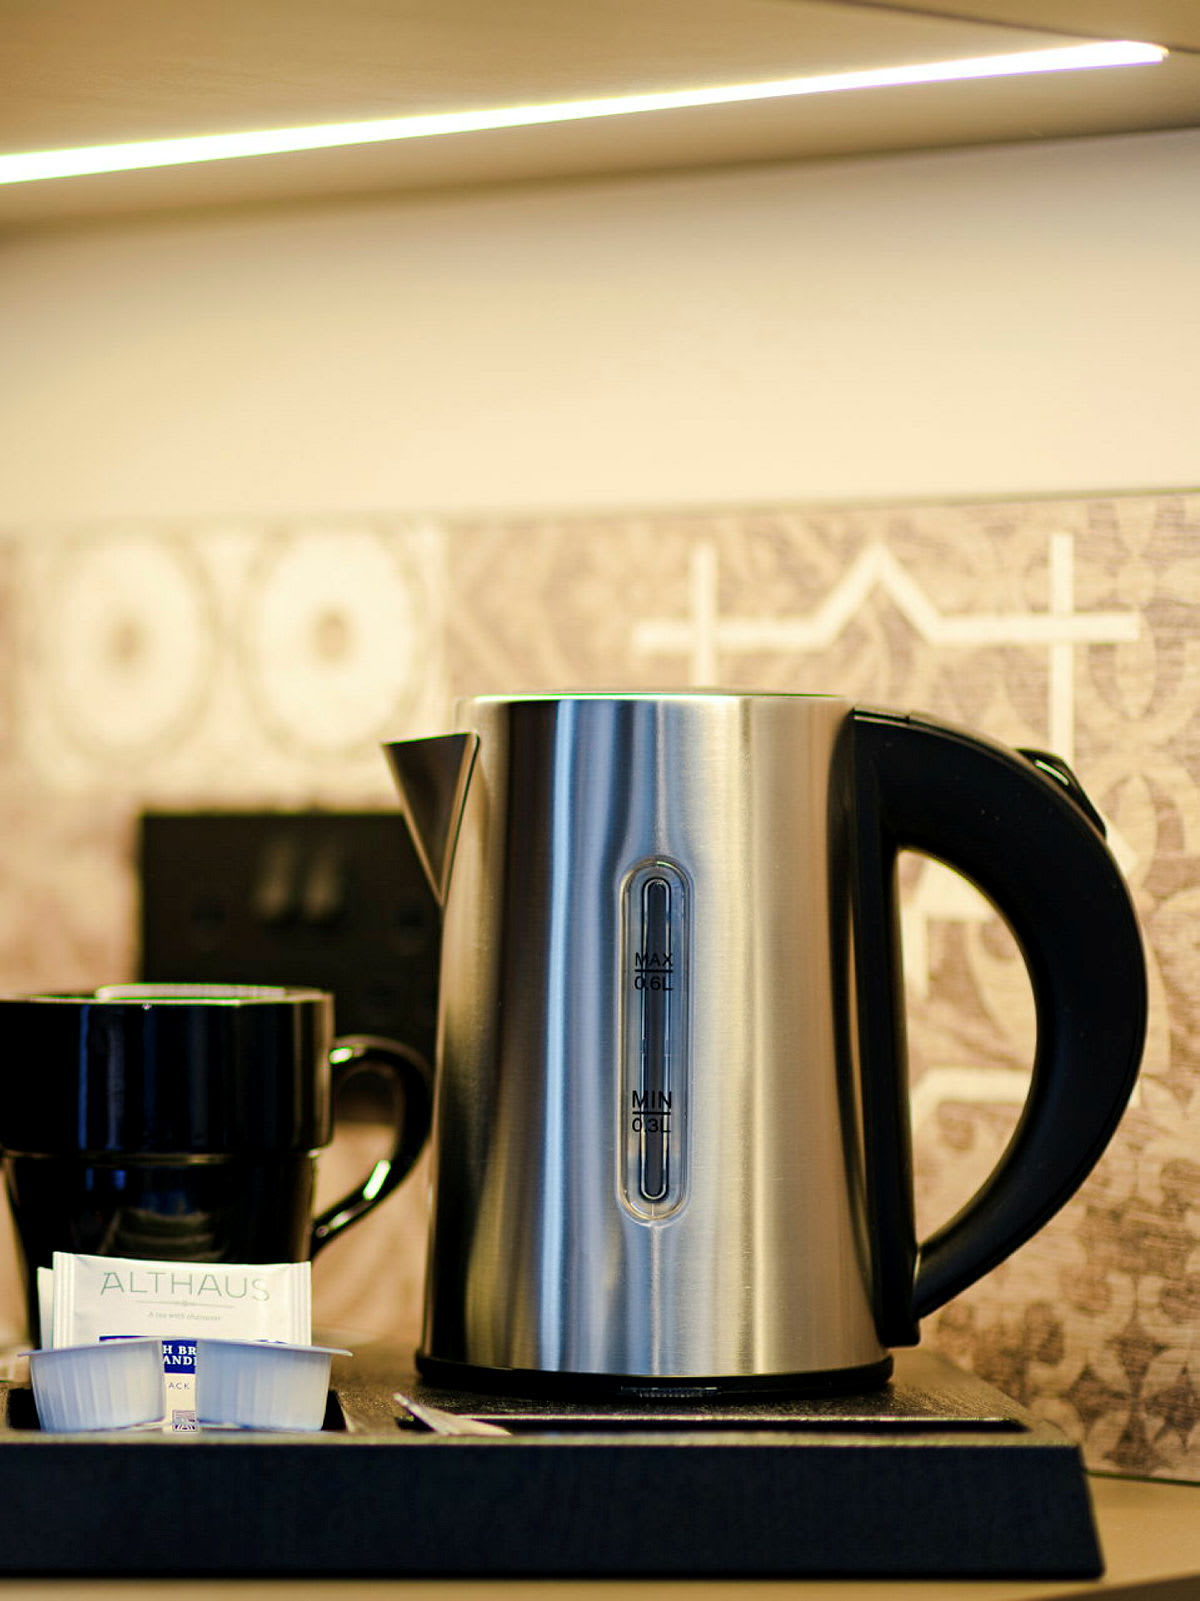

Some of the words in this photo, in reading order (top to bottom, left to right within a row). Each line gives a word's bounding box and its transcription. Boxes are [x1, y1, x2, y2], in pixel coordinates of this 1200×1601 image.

[634, 951, 674, 968] MAX
[633, 975, 675, 992] 0.6L
[631, 1090, 673, 1109] MIN
[631, 1117, 673, 1134] 0.3L
[100, 1271, 271, 1302] ALTHAUS
